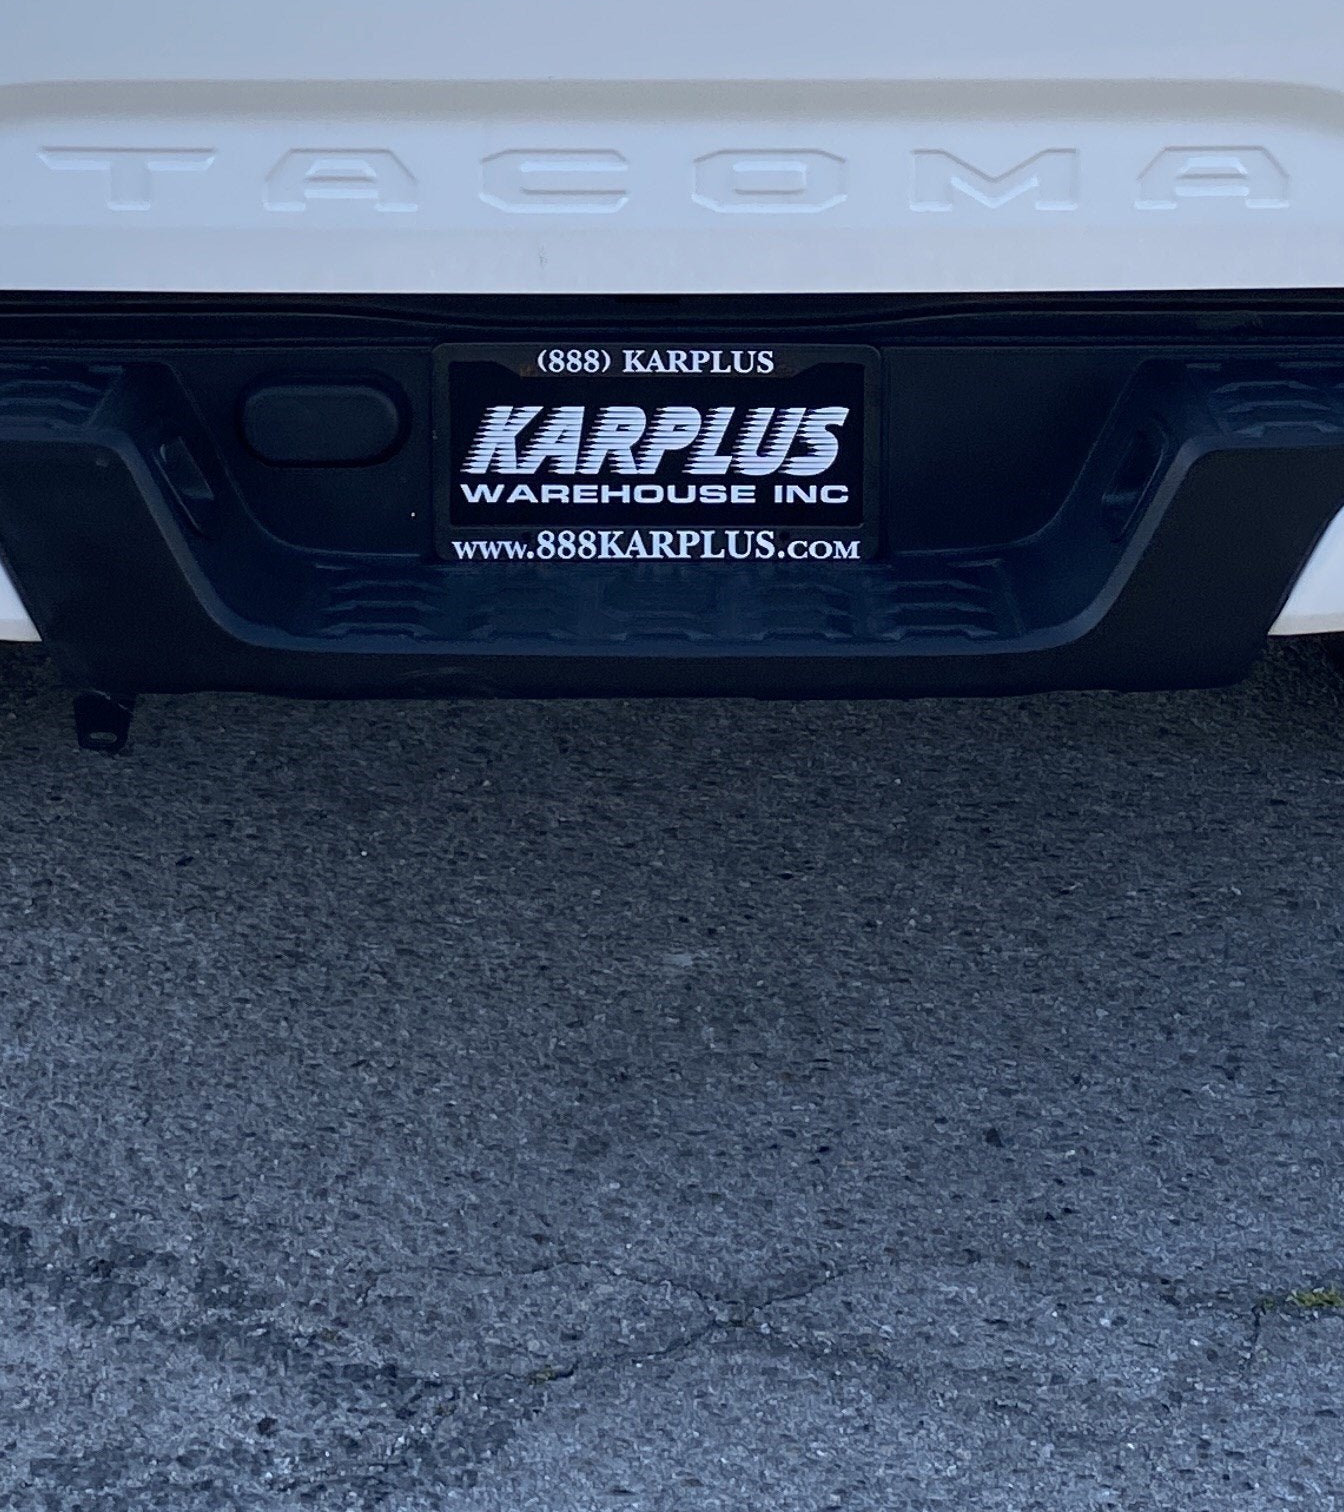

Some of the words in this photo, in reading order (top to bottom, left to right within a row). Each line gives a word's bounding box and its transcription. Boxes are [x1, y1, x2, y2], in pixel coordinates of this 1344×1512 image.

[37, 146, 1292, 214] TACOMA
[537, 348, 611, 374] (888)
[622, 349, 775, 374] KARPLUS
[460, 405, 850, 477] KARPLUS
[460, 484, 756, 504] WAREHOUSE
[774, 484, 850, 504] INC
